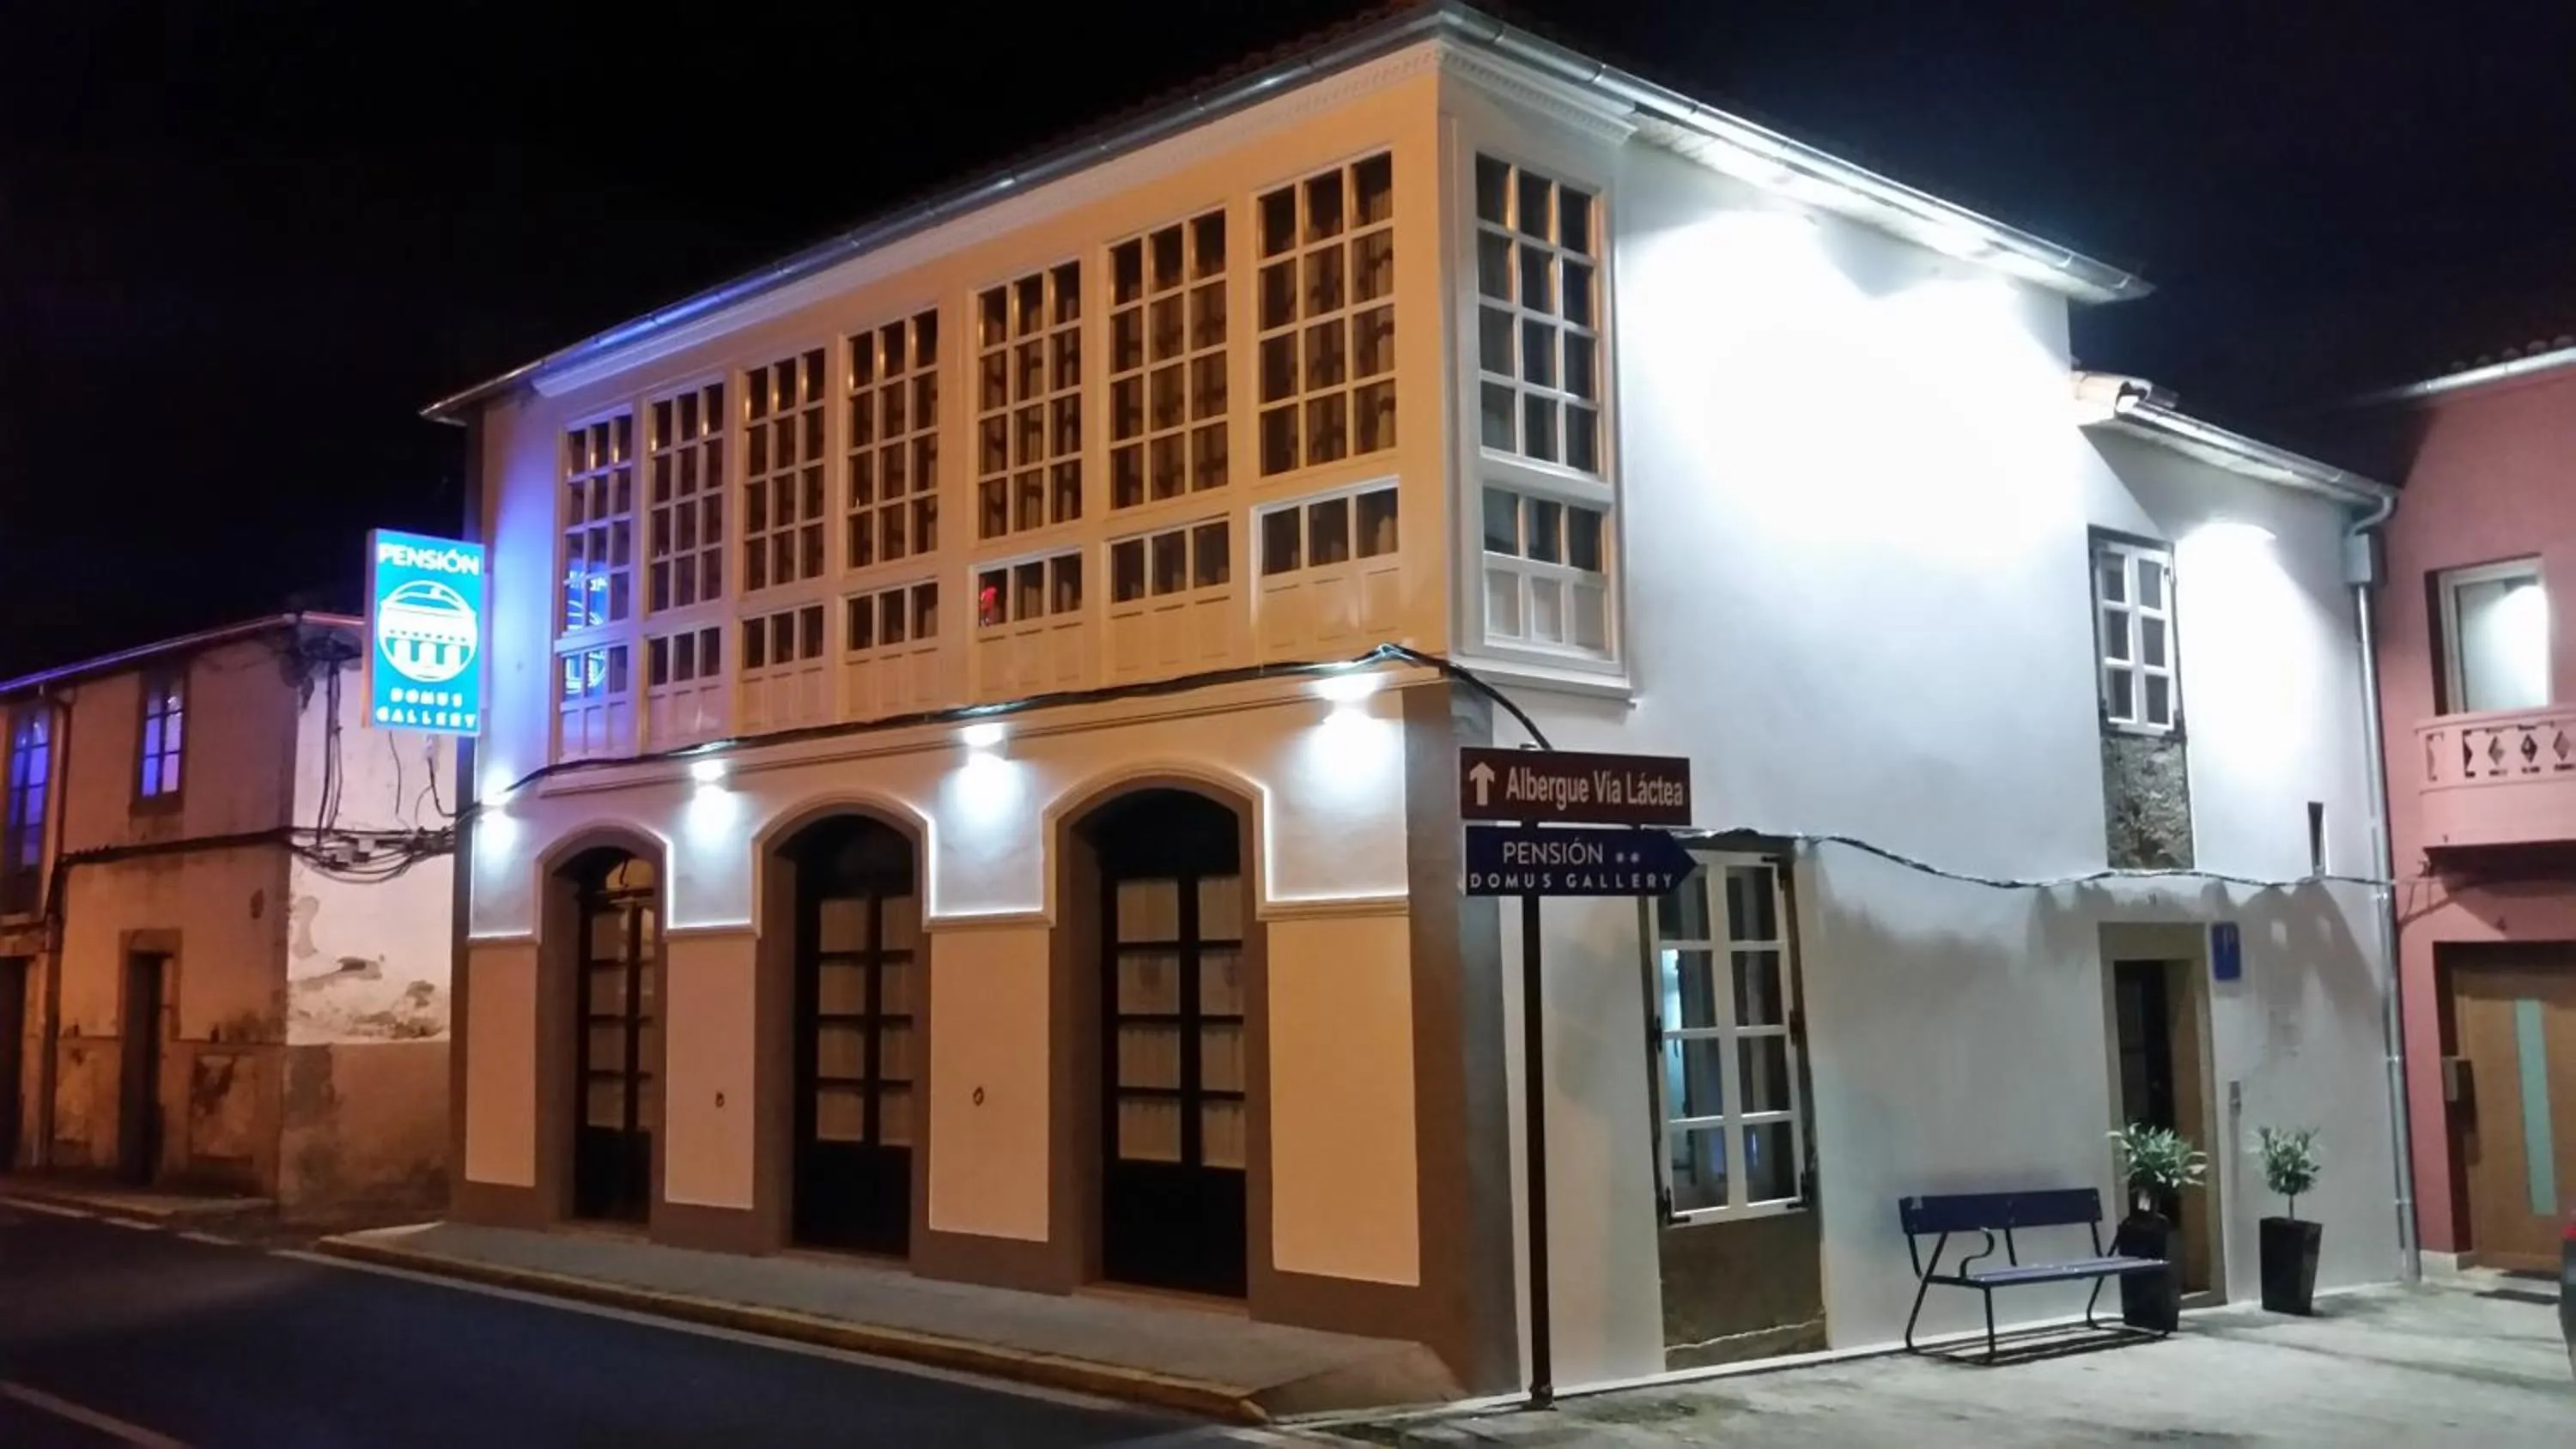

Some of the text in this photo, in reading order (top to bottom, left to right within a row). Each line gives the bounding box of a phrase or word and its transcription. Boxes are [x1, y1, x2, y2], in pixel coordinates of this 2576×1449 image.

[376, 543, 479, 576] PENSIÓN
[1506, 767, 1683, 810] Albergue Vía Láctea
[1503, 837, 1604, 865] PENSIÓN
[1469, 872, 1674, 889] DOMUS GALLERY
